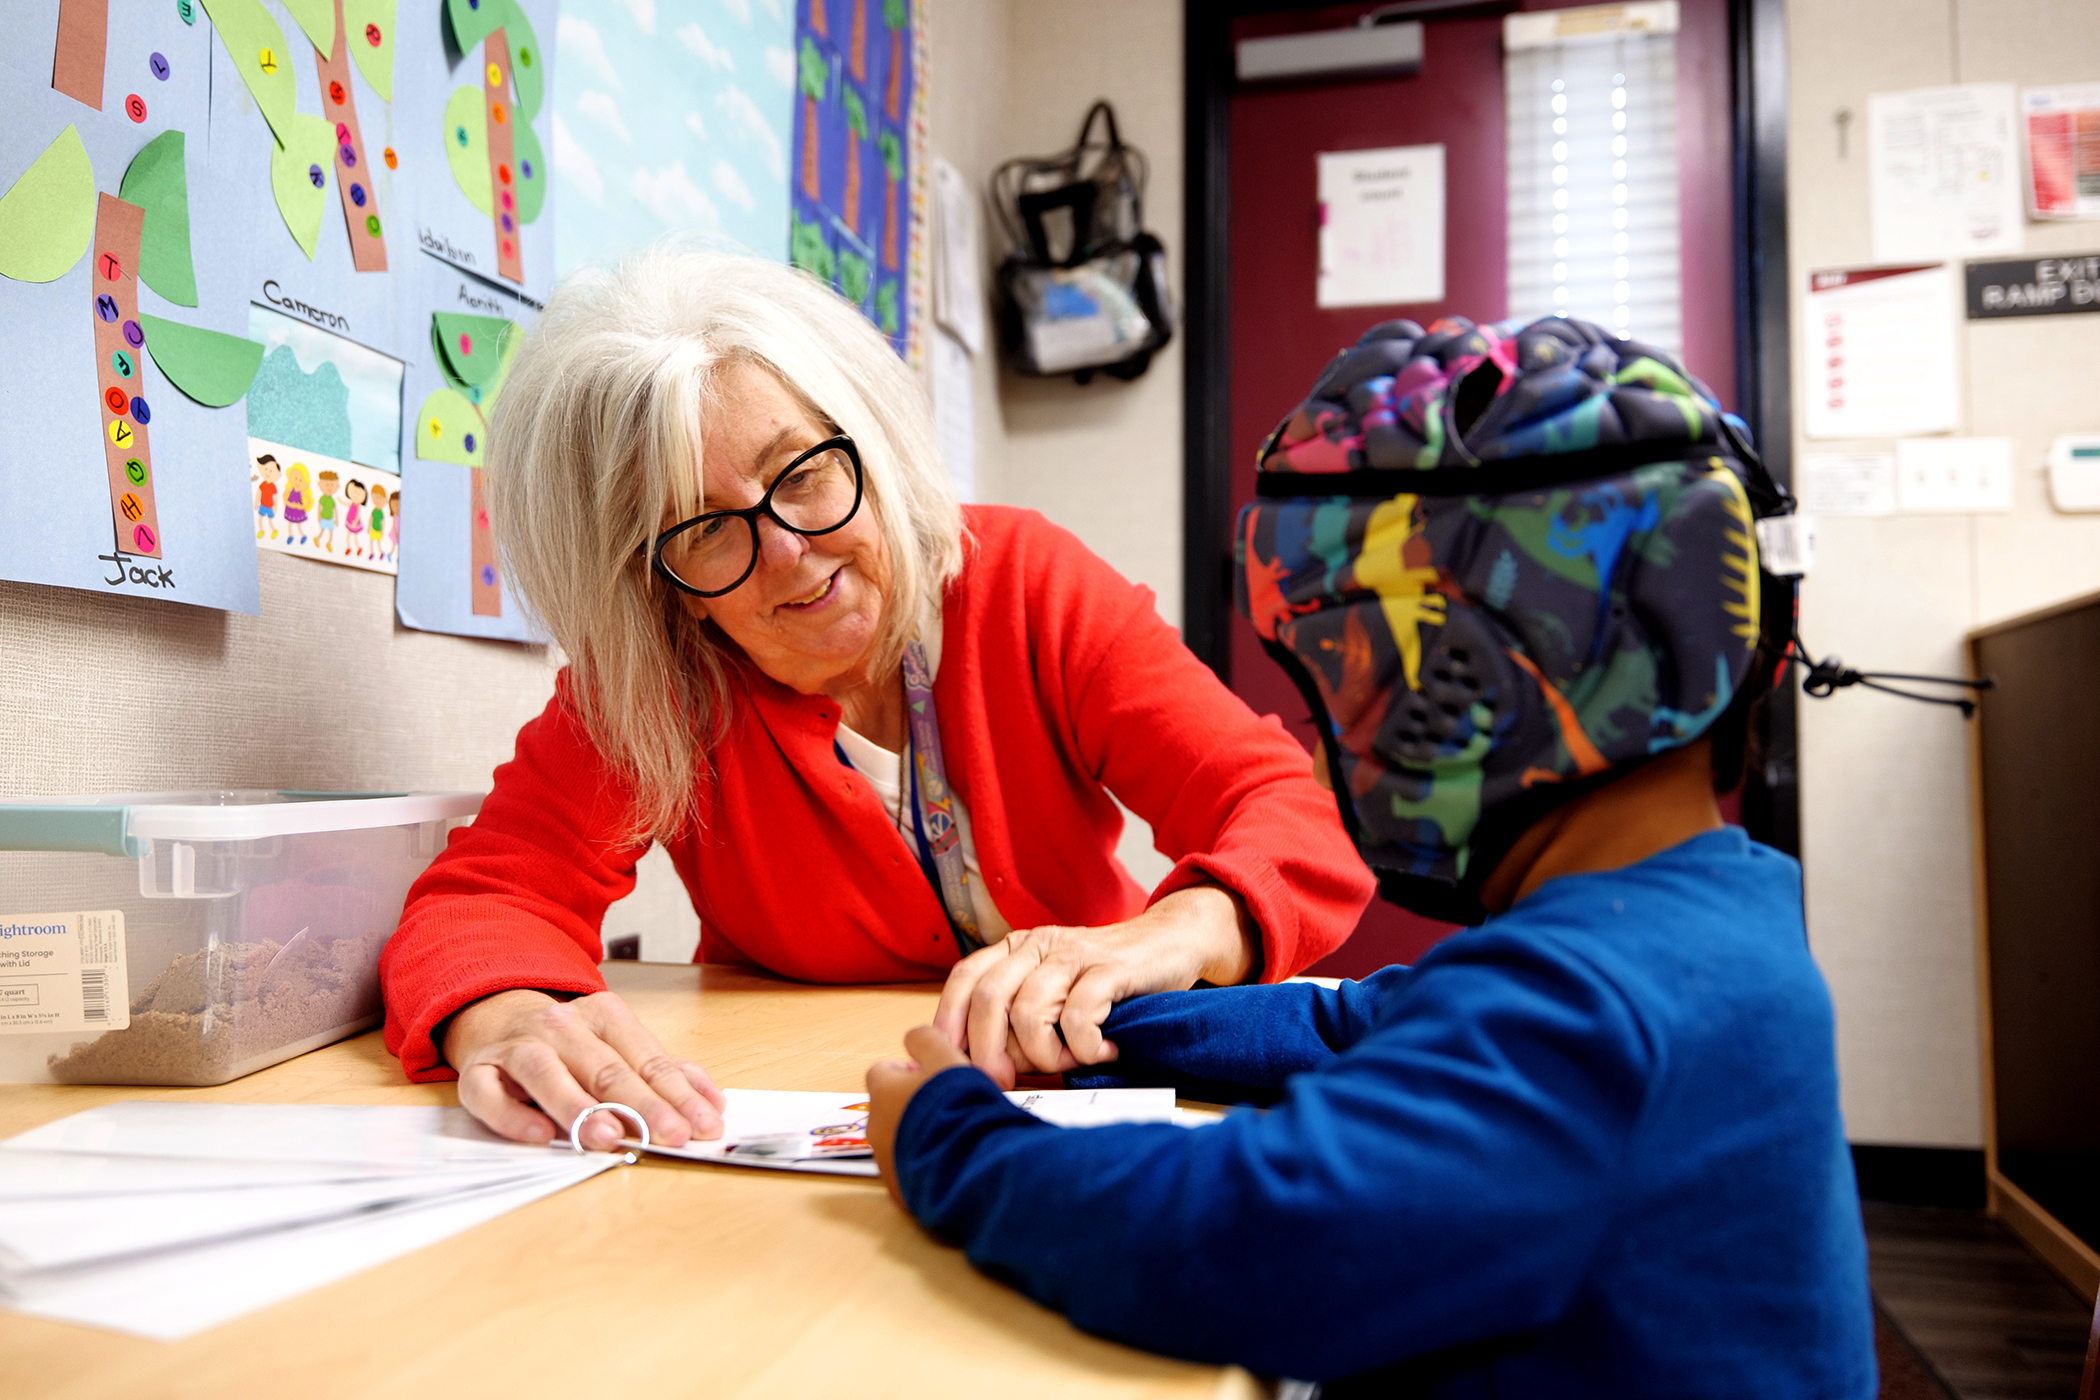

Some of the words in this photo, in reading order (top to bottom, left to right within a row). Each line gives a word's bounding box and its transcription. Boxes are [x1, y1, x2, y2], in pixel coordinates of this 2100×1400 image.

[131, 100, 144, 117] S
[104, 254, 118, 280] T
[263, 279, 350, 331] Cameron
[1981, 281, 2067, 310] RAMP
[97, 296, 119, 321] M
[126, 461, 145, 482] Q
[120, 493, 142, 520] H
[98, 551, 176, 589] Jack
[0, 960, 17, 968] with
[18, 960, 31, 968] Lid
[21, 950, 54, 959] Storage
[4, 989, 26, 997] quart
